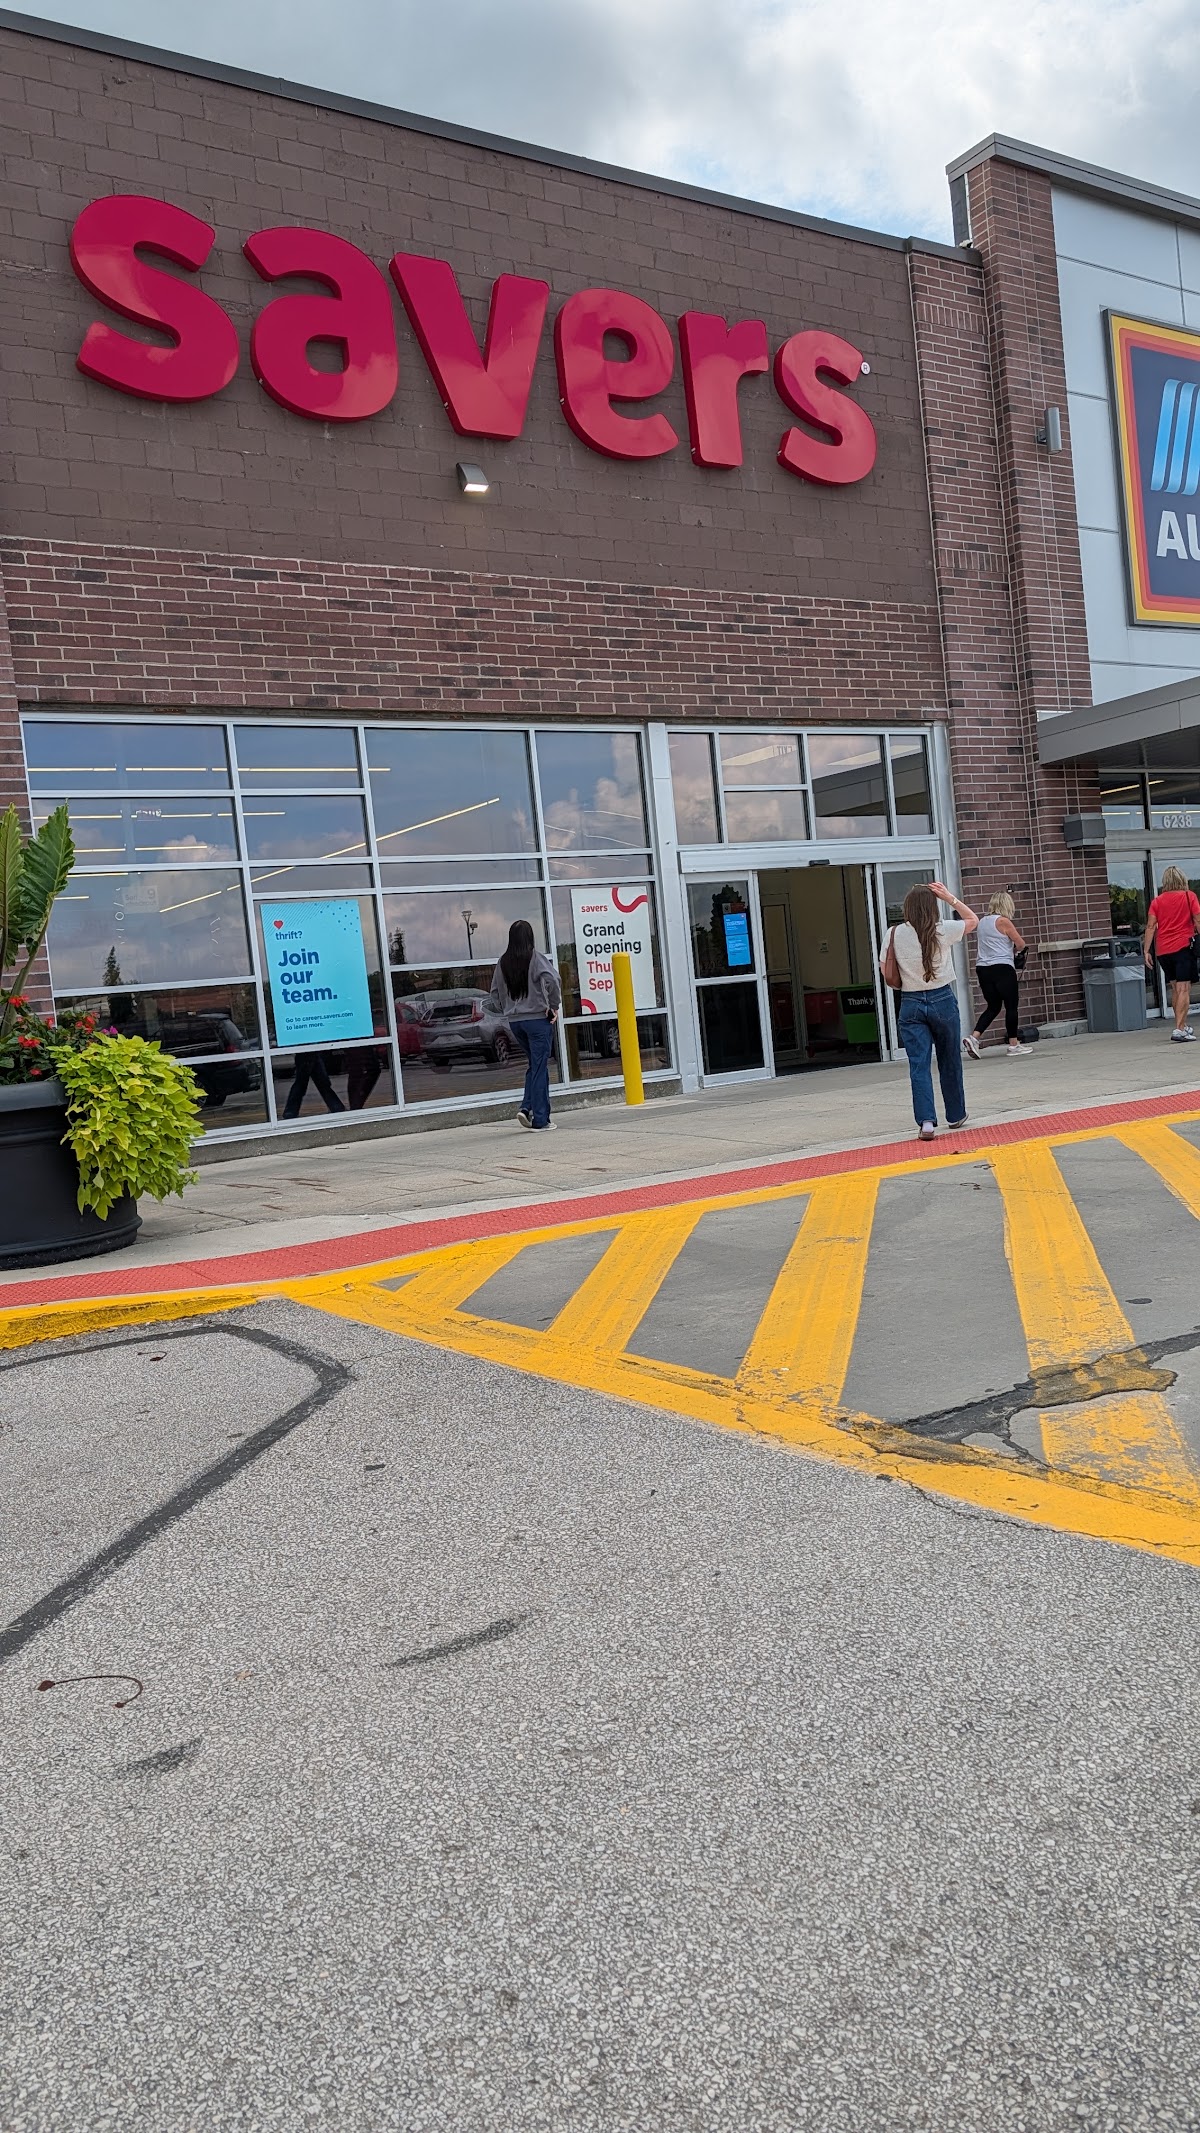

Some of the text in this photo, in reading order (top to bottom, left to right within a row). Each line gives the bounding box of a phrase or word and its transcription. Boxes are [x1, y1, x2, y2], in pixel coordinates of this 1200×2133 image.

[69, 193, 878, 486] savers
[1163, 814, 1192, 828] 6238
[581, 904, 608, 912] savers
[275, 930, 303, 940] thrift?
[582, 921, 625, 937] Grand
[584, 938, 642, 957] opening
[278, 948, 319, 967] Join
[280, 970, 313, 986] our
[281, 987, 338, 1004] team.
[847, 996, 869, 1006] Thank
[302, 1012, 354, 1022] careers.savers.com
